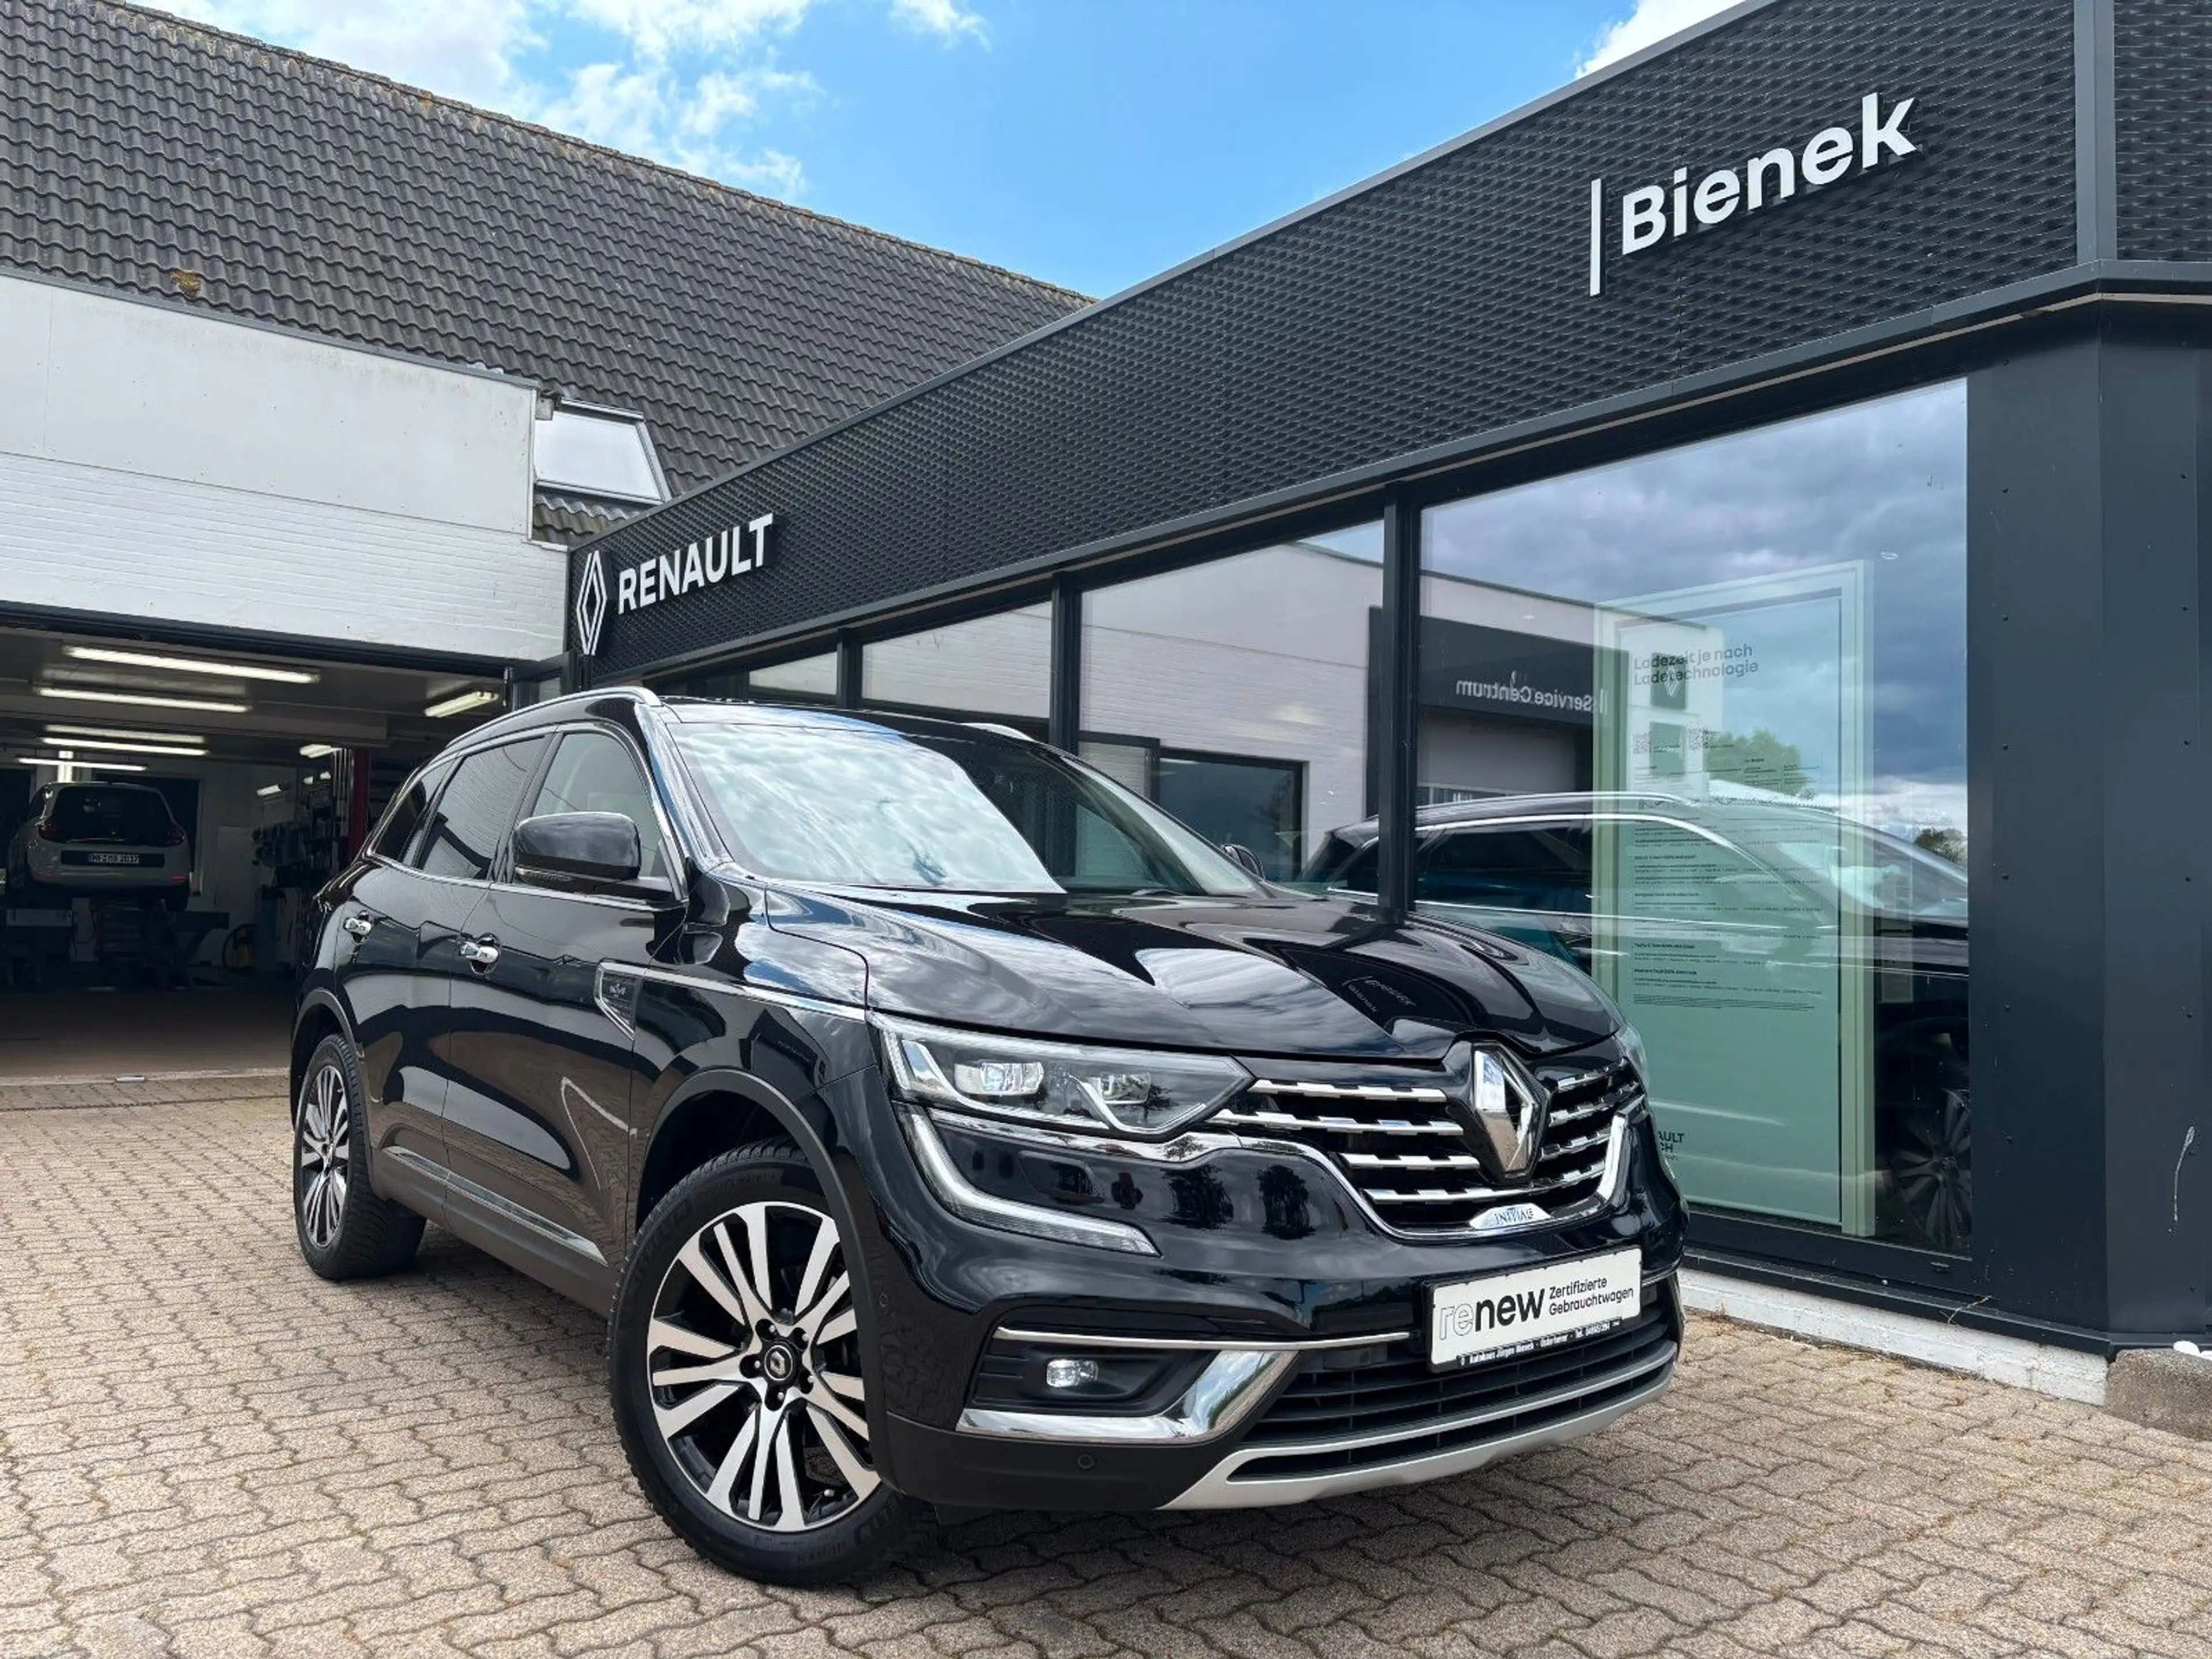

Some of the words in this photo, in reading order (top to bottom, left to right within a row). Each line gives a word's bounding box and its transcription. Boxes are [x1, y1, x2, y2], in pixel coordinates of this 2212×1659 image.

[1622, 92, 1916, 255] Bienek
[618, 513, 773, 614] RENAULT
[1698, 649, 1710, 664] je
[1714, 643, 1752, 661] nach
[1549, 1287, 1634, 1316] Gebrauchtwagen
[1550, 1278, 1608, 1300] Zertifizierte
[1440, 1289, 1545, 1340] renew
